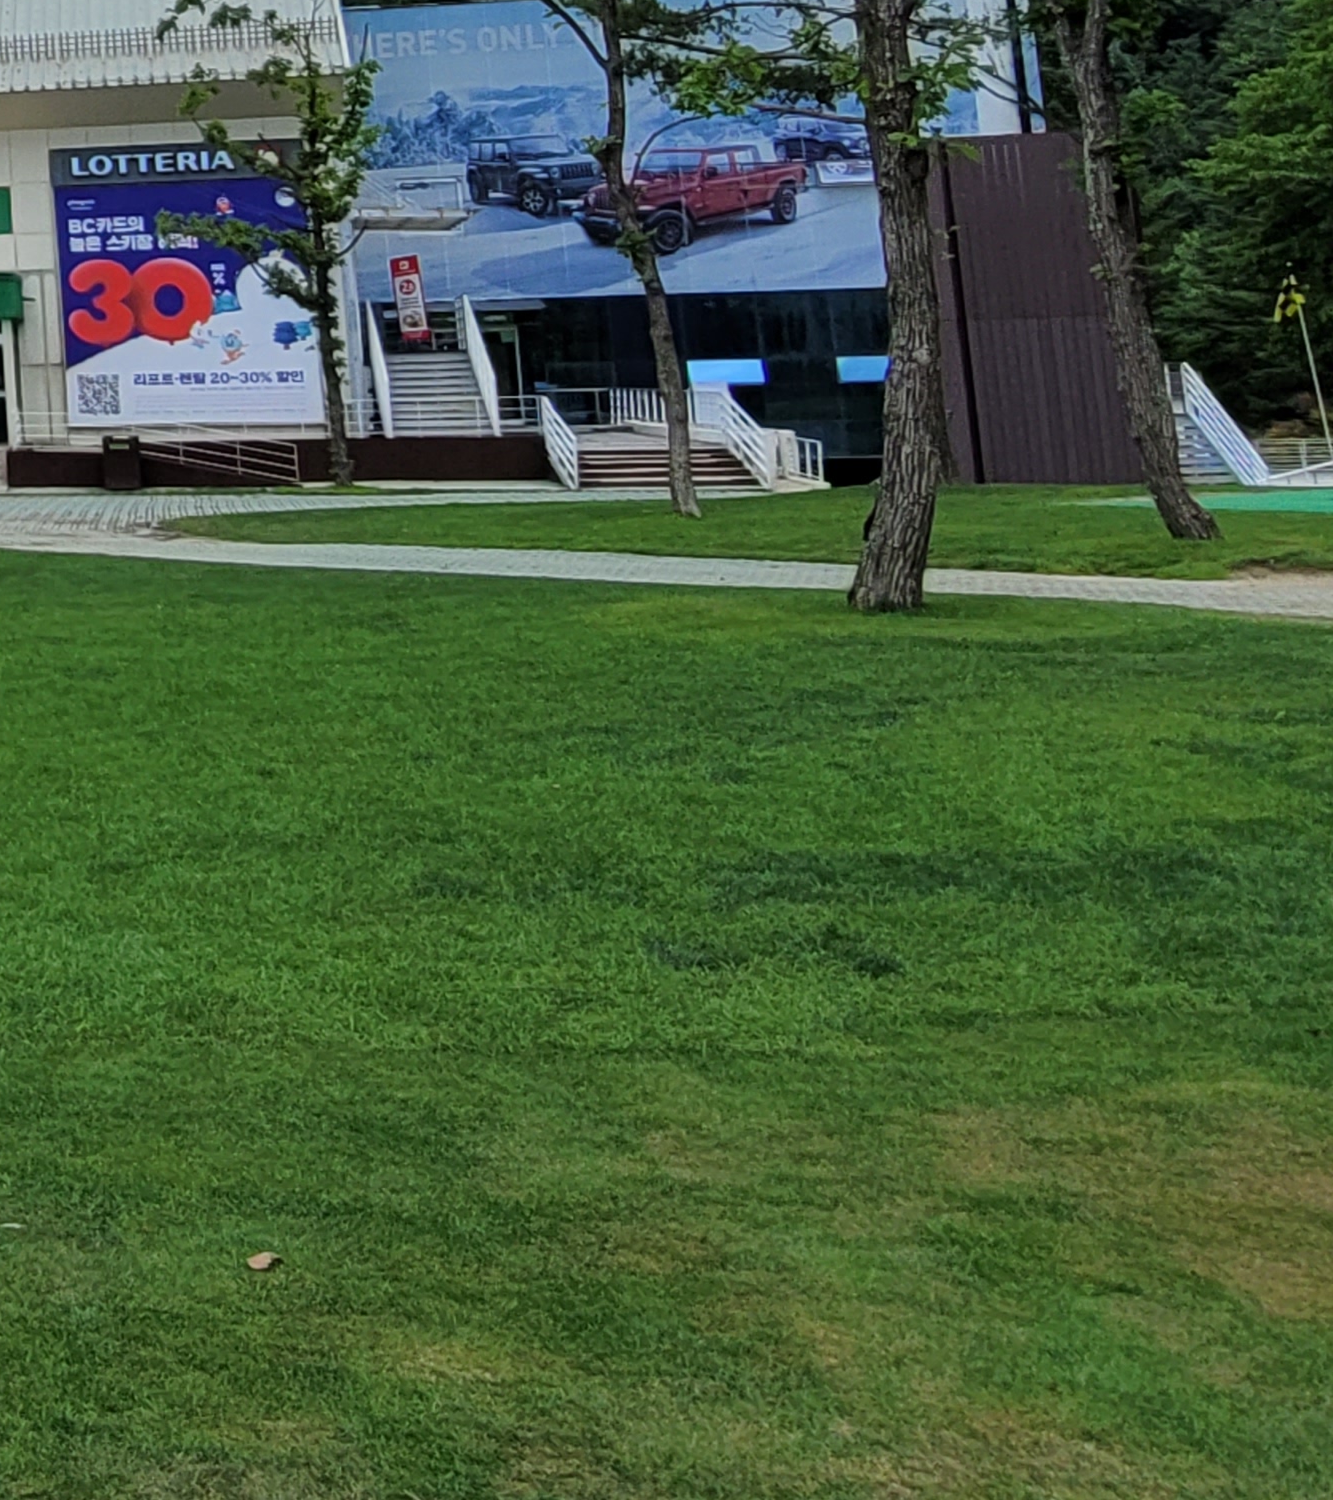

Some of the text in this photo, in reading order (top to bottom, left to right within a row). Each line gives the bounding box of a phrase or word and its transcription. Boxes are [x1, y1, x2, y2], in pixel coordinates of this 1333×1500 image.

[352, 21, 562, 60] HERE'S ONLY
[70, 151, 235, 177] LOTTERIA
[68, 216, 145, 234] BC카드의
[68, 257, 214, 348] 30
